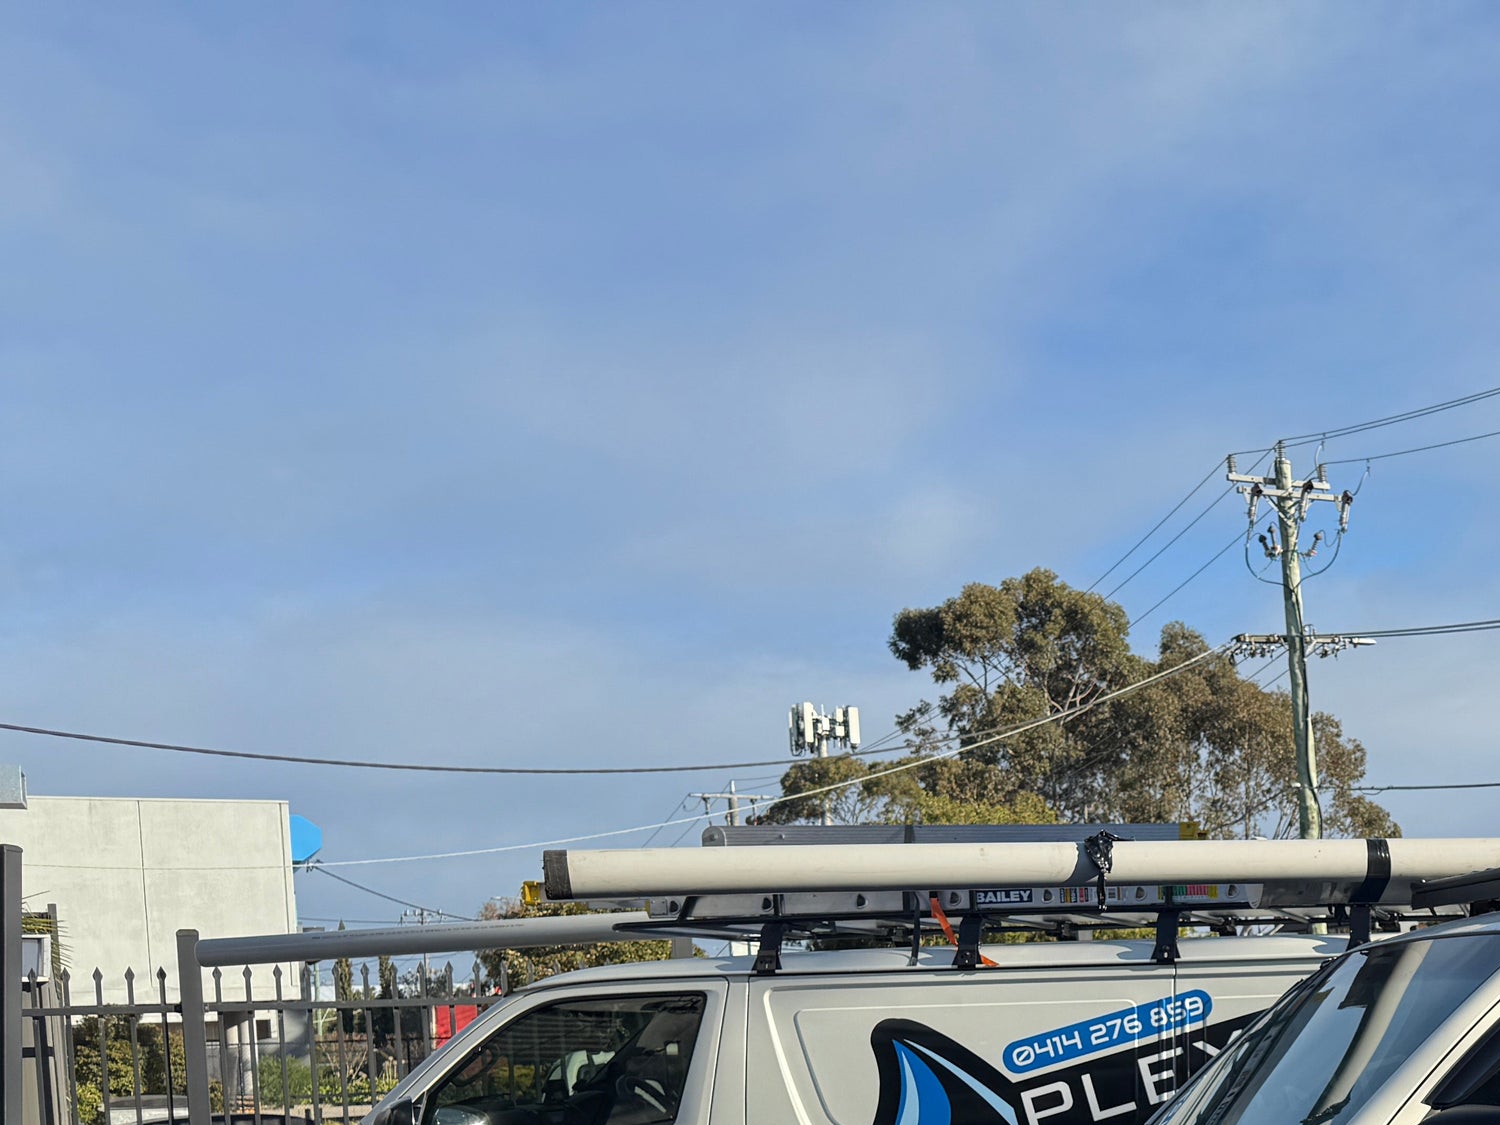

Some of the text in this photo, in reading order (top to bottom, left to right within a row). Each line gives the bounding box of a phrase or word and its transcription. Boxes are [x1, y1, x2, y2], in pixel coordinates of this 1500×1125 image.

[976, 890, 1031, 903] BAILEY
[1011, 995, 1204, 1067] 0414 276 859
